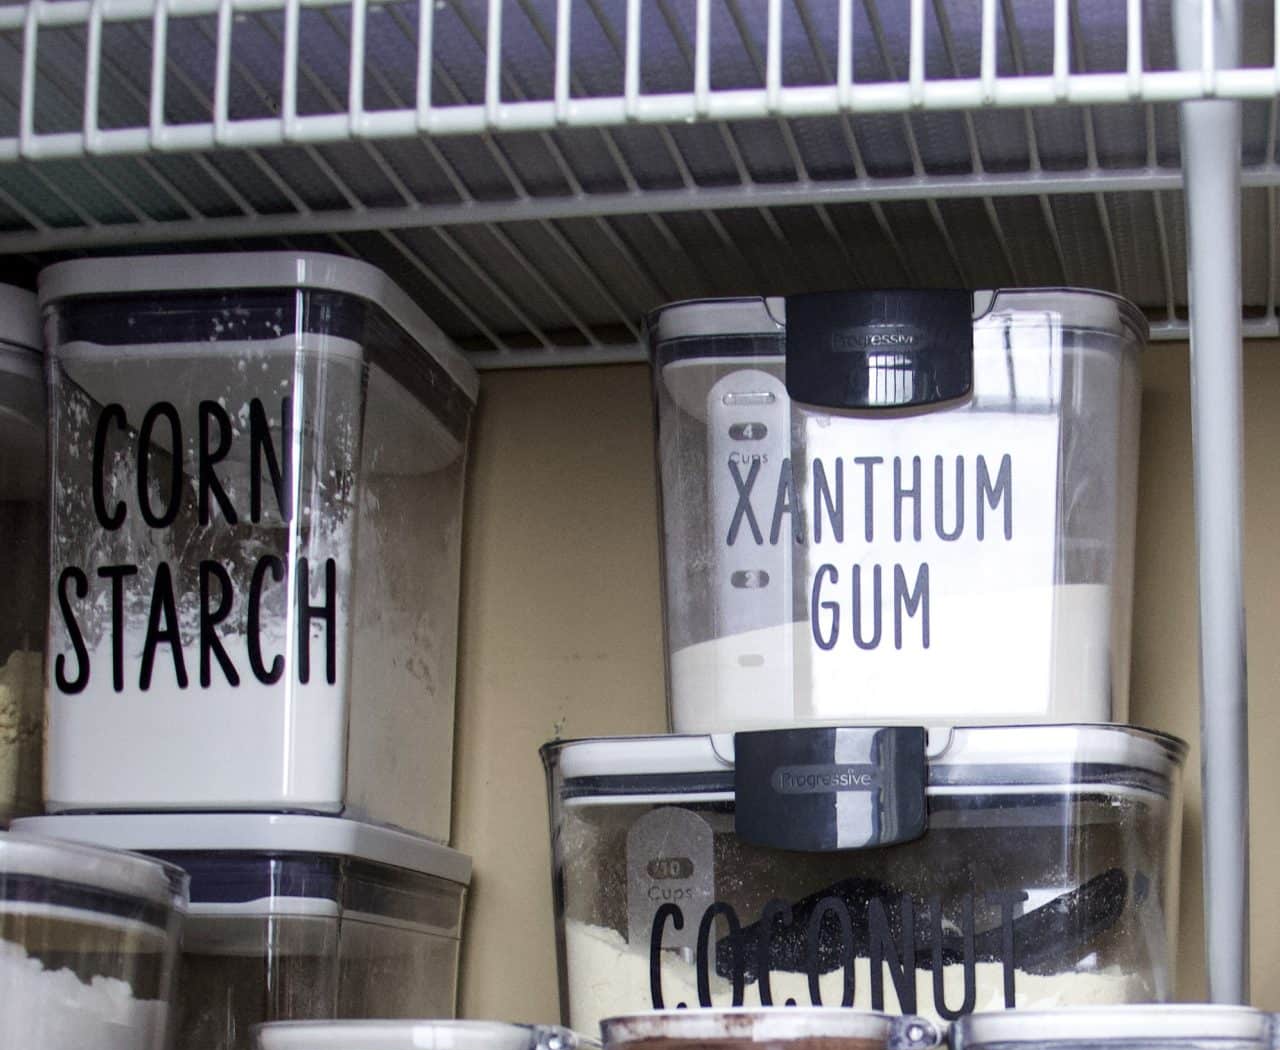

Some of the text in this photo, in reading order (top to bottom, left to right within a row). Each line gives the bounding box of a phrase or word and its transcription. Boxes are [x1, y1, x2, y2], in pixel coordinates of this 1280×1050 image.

[91, 397, 295, 531] CORN
[726, 453, 1014, 546] XANTHUM
[54, 554, 337, 696] STARCH
[809, 561, 931, 651] GUM
[649, 893, 1030, 1020] COCONUT
